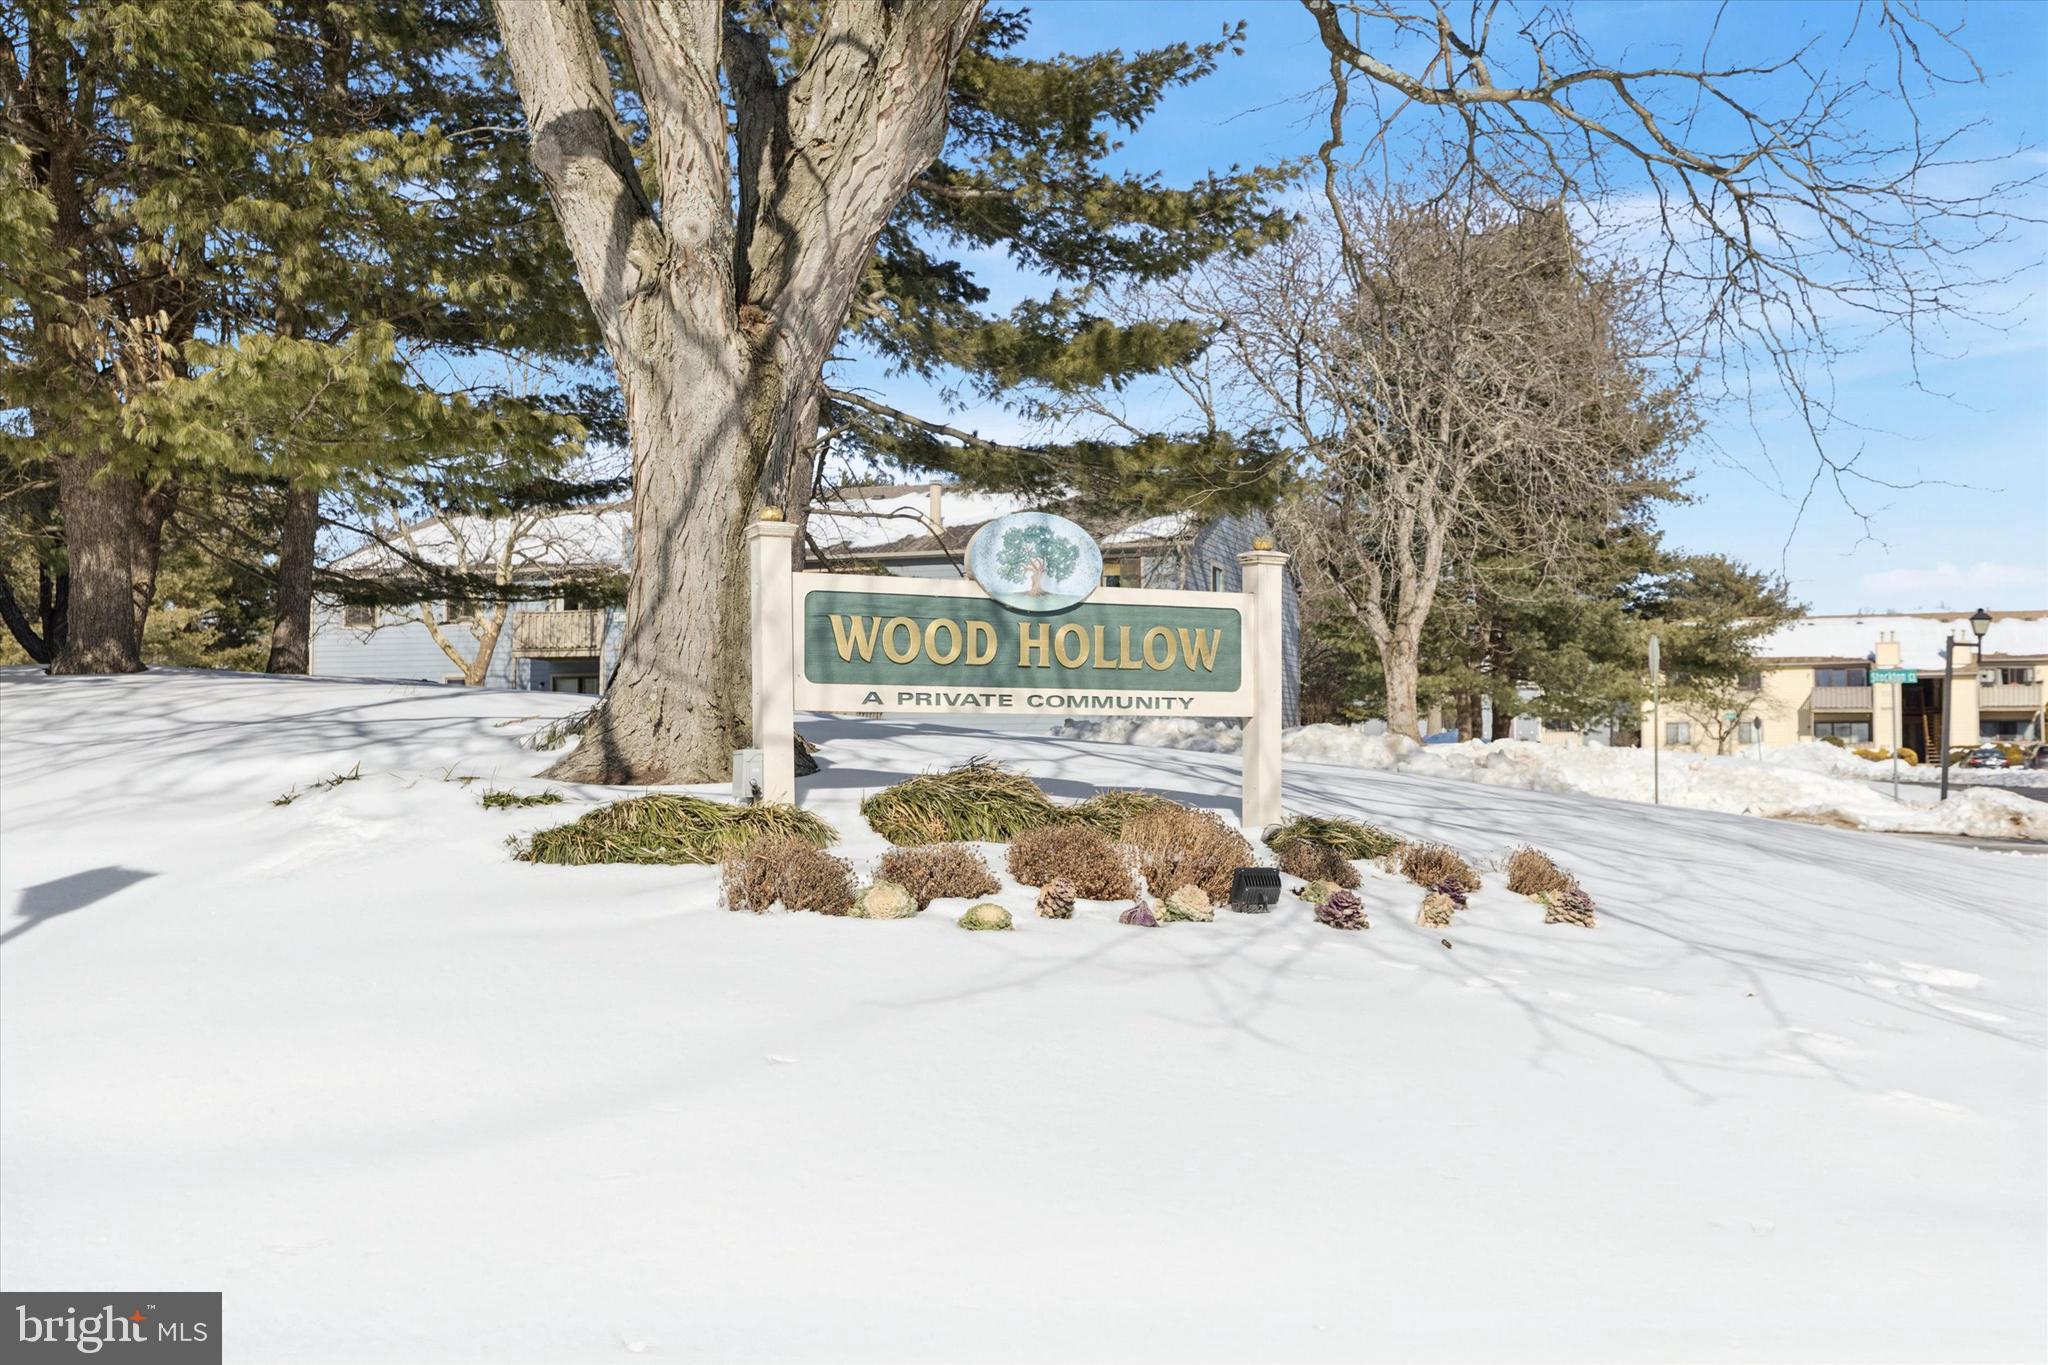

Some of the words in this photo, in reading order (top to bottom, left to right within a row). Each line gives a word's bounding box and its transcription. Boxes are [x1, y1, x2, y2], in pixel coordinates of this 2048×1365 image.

[827, 614, 999, 666] WOOD
[1018, 622, 1223, 673] HOLLOW
[861, 691, 884, 705] A
[897, 692, 1013, 707] PRIVATE
[1026, 694, 1195, 710] COMMUNITY
